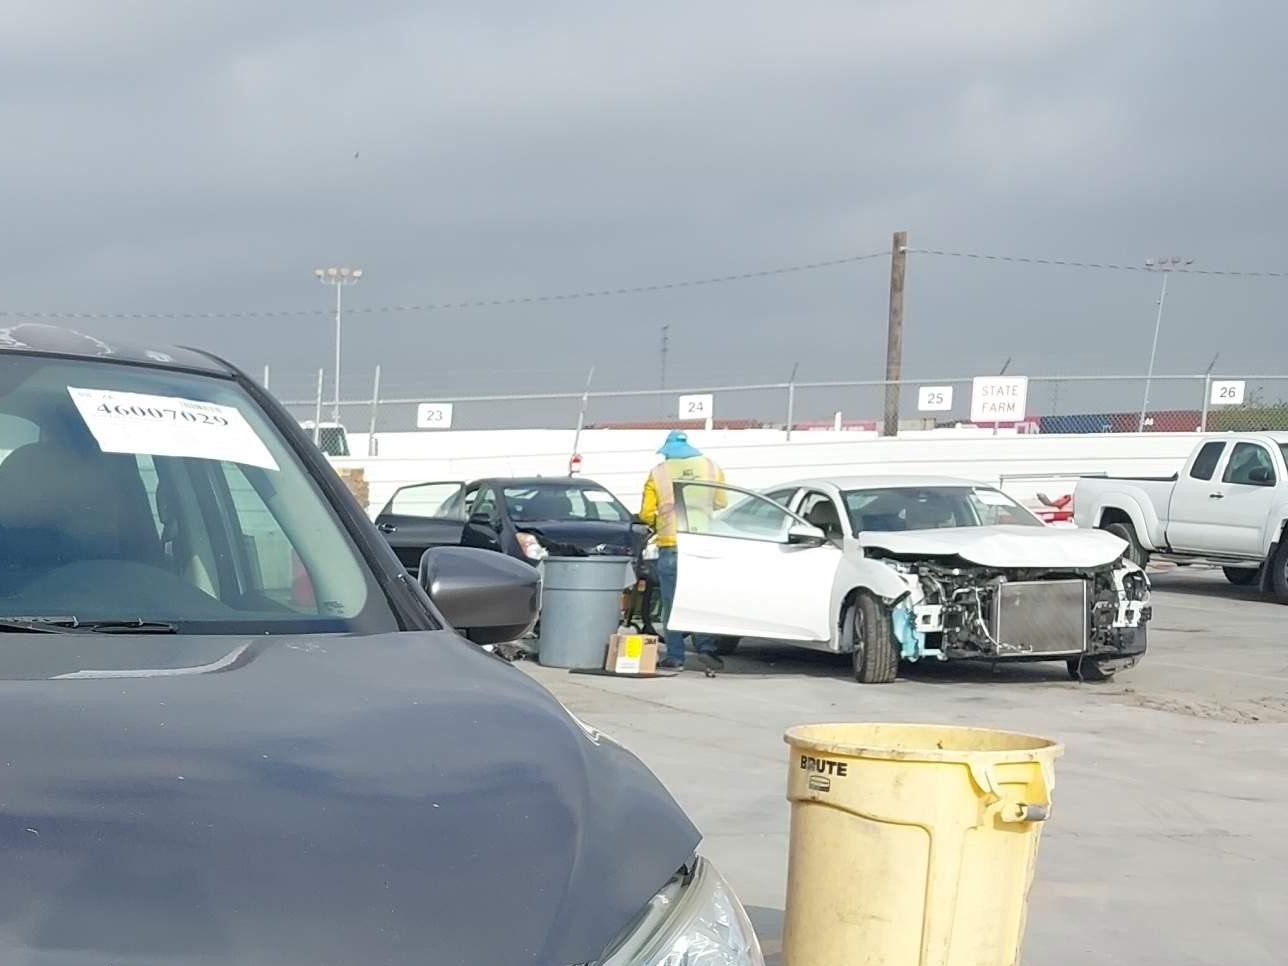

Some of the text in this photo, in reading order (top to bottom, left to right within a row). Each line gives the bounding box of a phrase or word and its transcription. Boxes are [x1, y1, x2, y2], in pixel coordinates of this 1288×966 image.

[981, 384, 1019, 398] STATE
[1219, 386, 1237, 400] 26
[927, 392, 945, 406] 25
[687, 401, 704, 414] 24
[981, 400, 1017, 414] FARM
[96, 402, 229, 427] 46007029
[426, 409, 444, 422] 23
[799, 754, 849, 777] BRUTE
